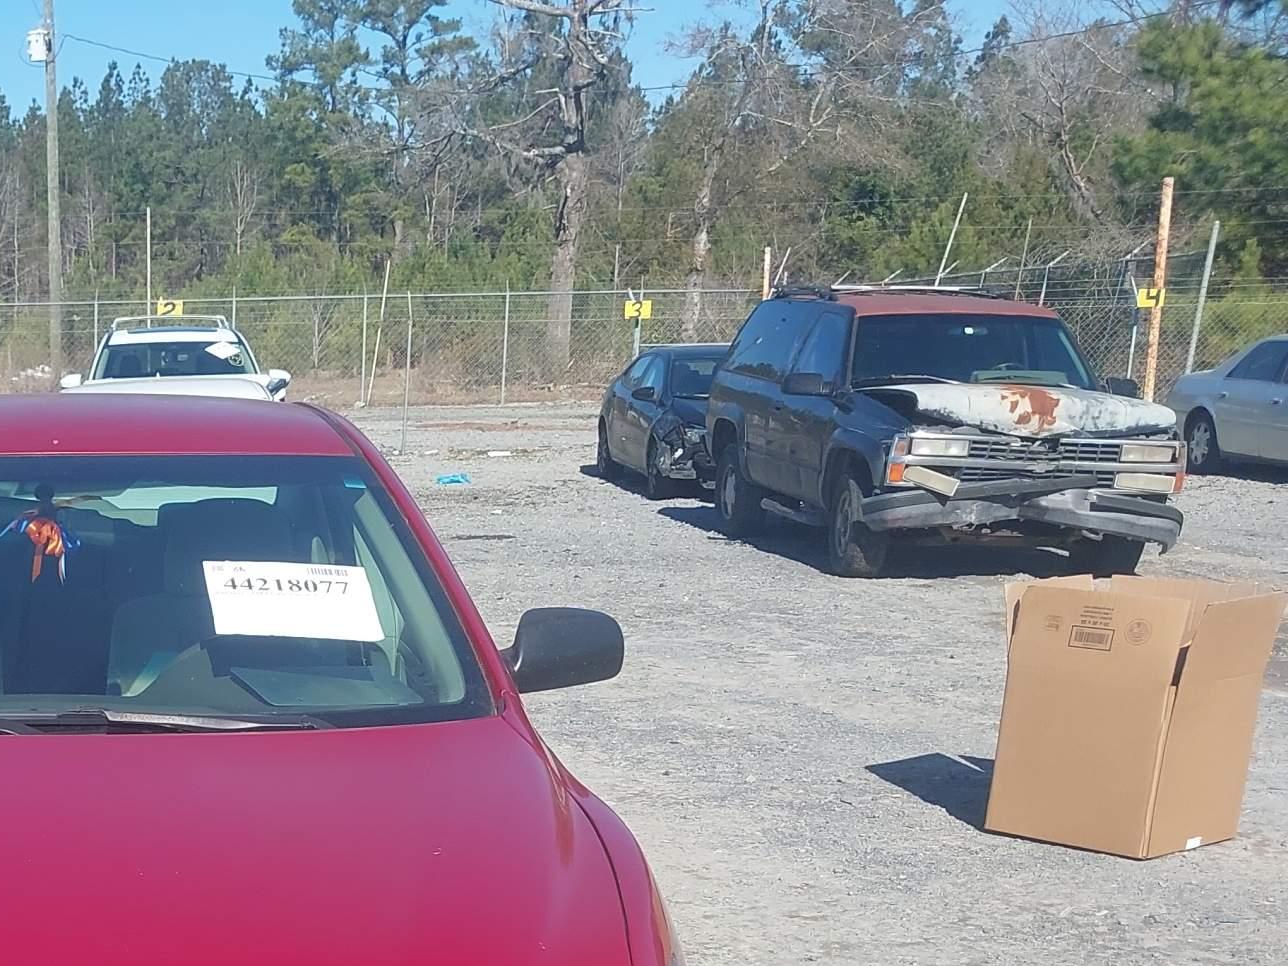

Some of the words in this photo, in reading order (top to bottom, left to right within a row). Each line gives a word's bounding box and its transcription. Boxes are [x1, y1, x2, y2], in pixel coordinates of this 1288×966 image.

[1146, 288, 1161, 307] 4
[160, 302, 176, 316] 2
[629, 301, 642, 318] 3
[223, 577, 349, 595] 44218077
